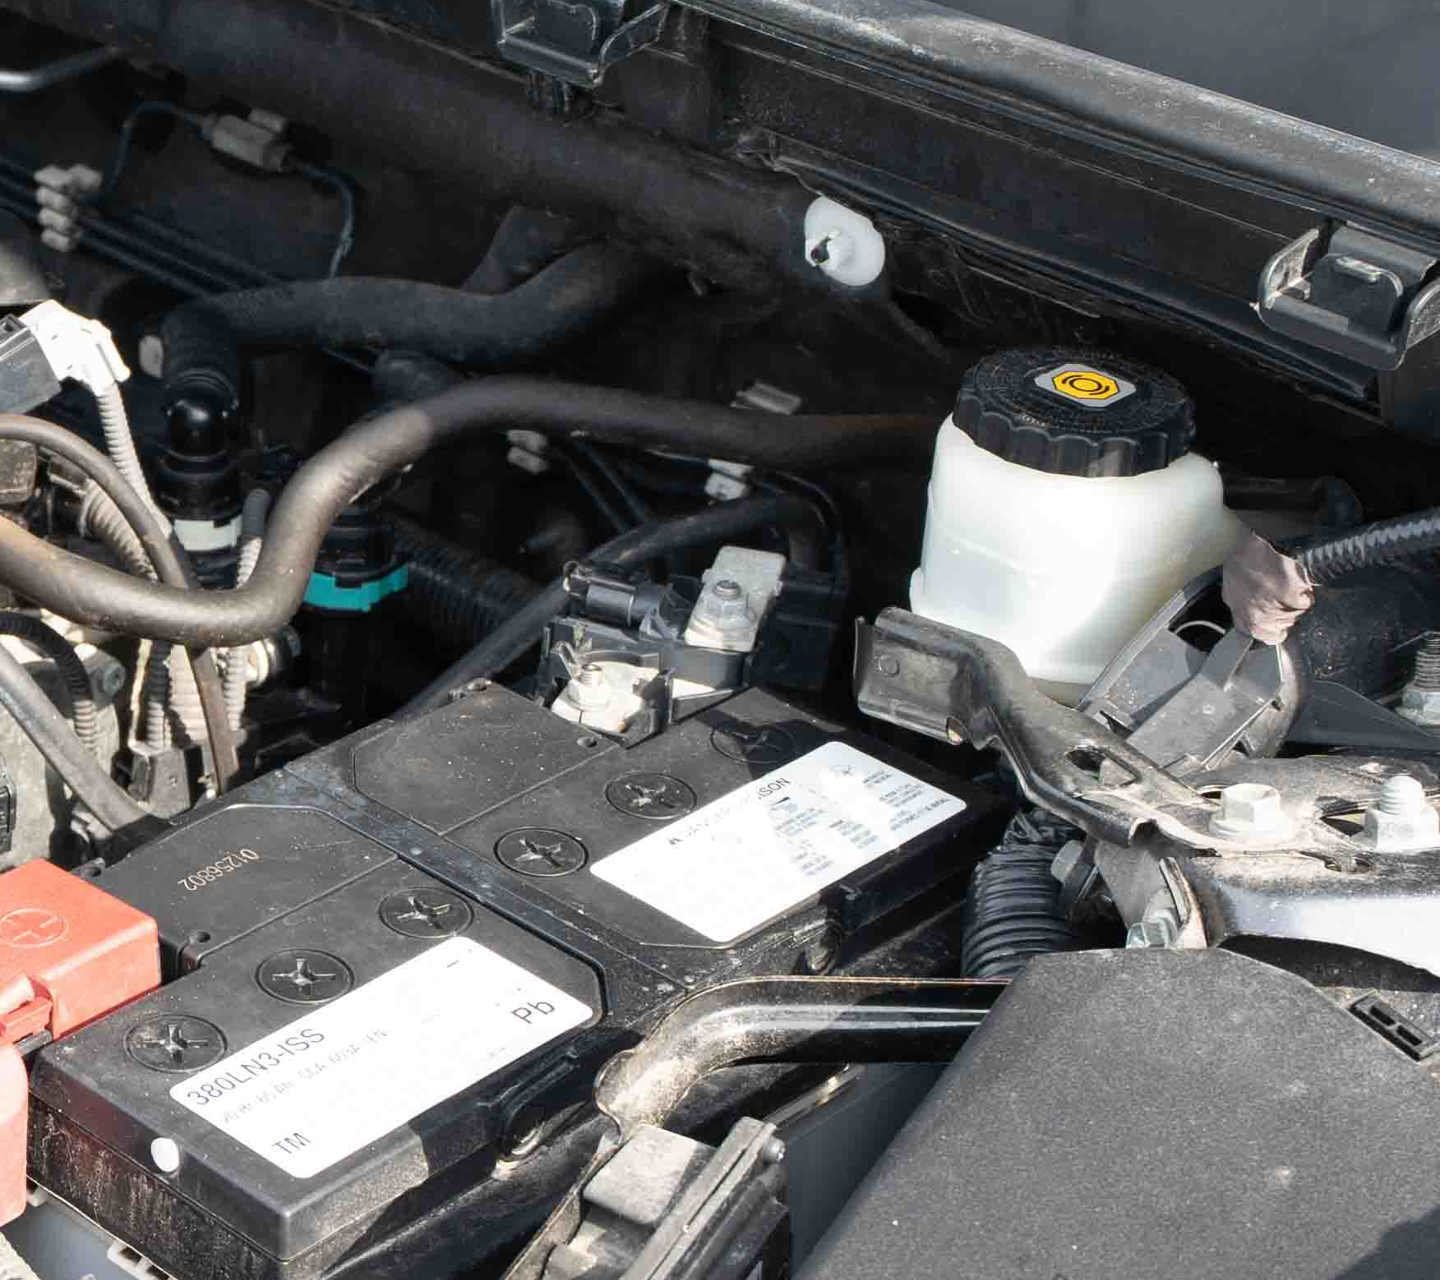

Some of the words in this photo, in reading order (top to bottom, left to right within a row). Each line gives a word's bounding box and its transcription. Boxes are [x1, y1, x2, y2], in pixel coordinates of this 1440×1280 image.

[177, 848, 259, 891] 01256802
[510, 1000, 556, 1025] Pb
[187, 1027, 327, 1107] 380LN3-ISS
[271, 1130, 312, 1156] TM
